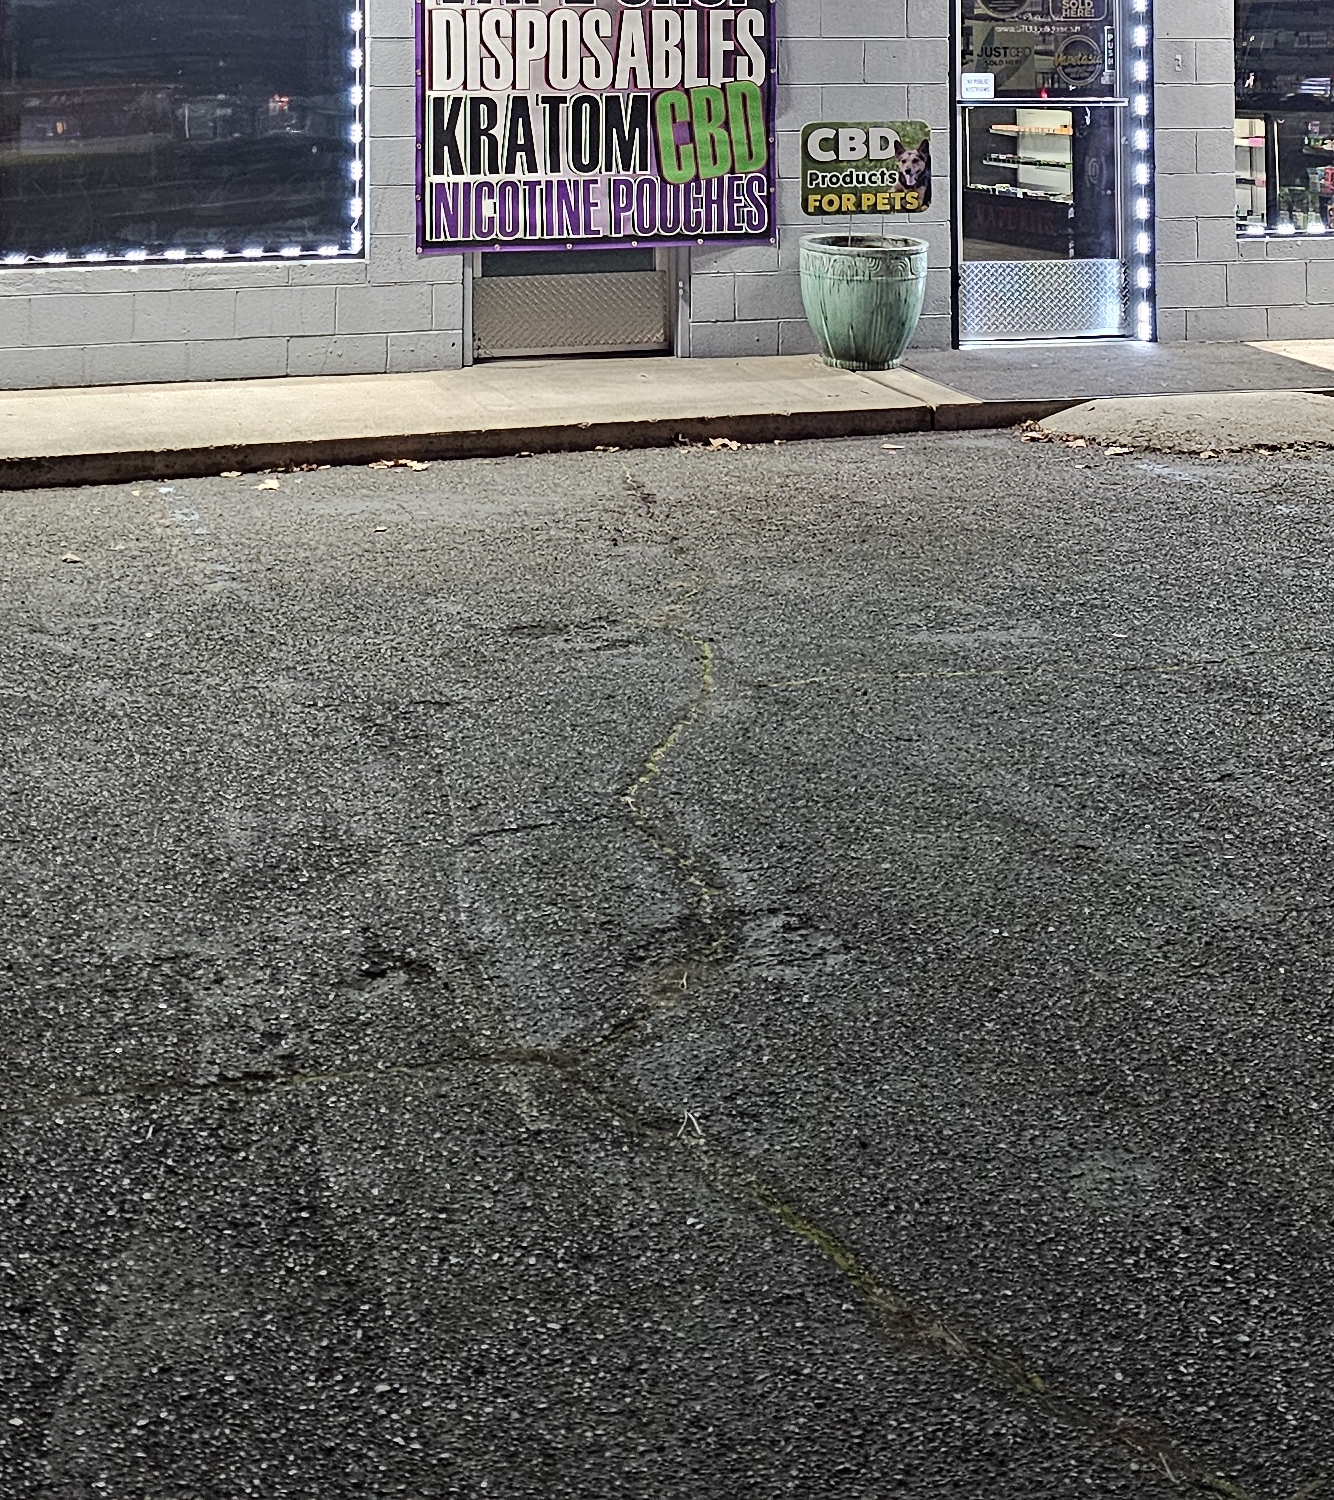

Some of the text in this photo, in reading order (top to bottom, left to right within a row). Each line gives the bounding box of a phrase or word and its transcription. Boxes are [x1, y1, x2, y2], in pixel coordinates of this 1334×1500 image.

[1062, 0, 1094, 9] SOLD
[1063, 8, 1095, 18] HERE!
[428, 8, 767, 92] DISPOSABLES
[427, 80, 768, 185] KRATOM CBD
[807, 127, 901, 162] CBD
[807, 168, 899, 188] Products
[427, 173, 769, 242] NICOTINE POUCHES
[807, 191, 919, 213] FOR PETS
